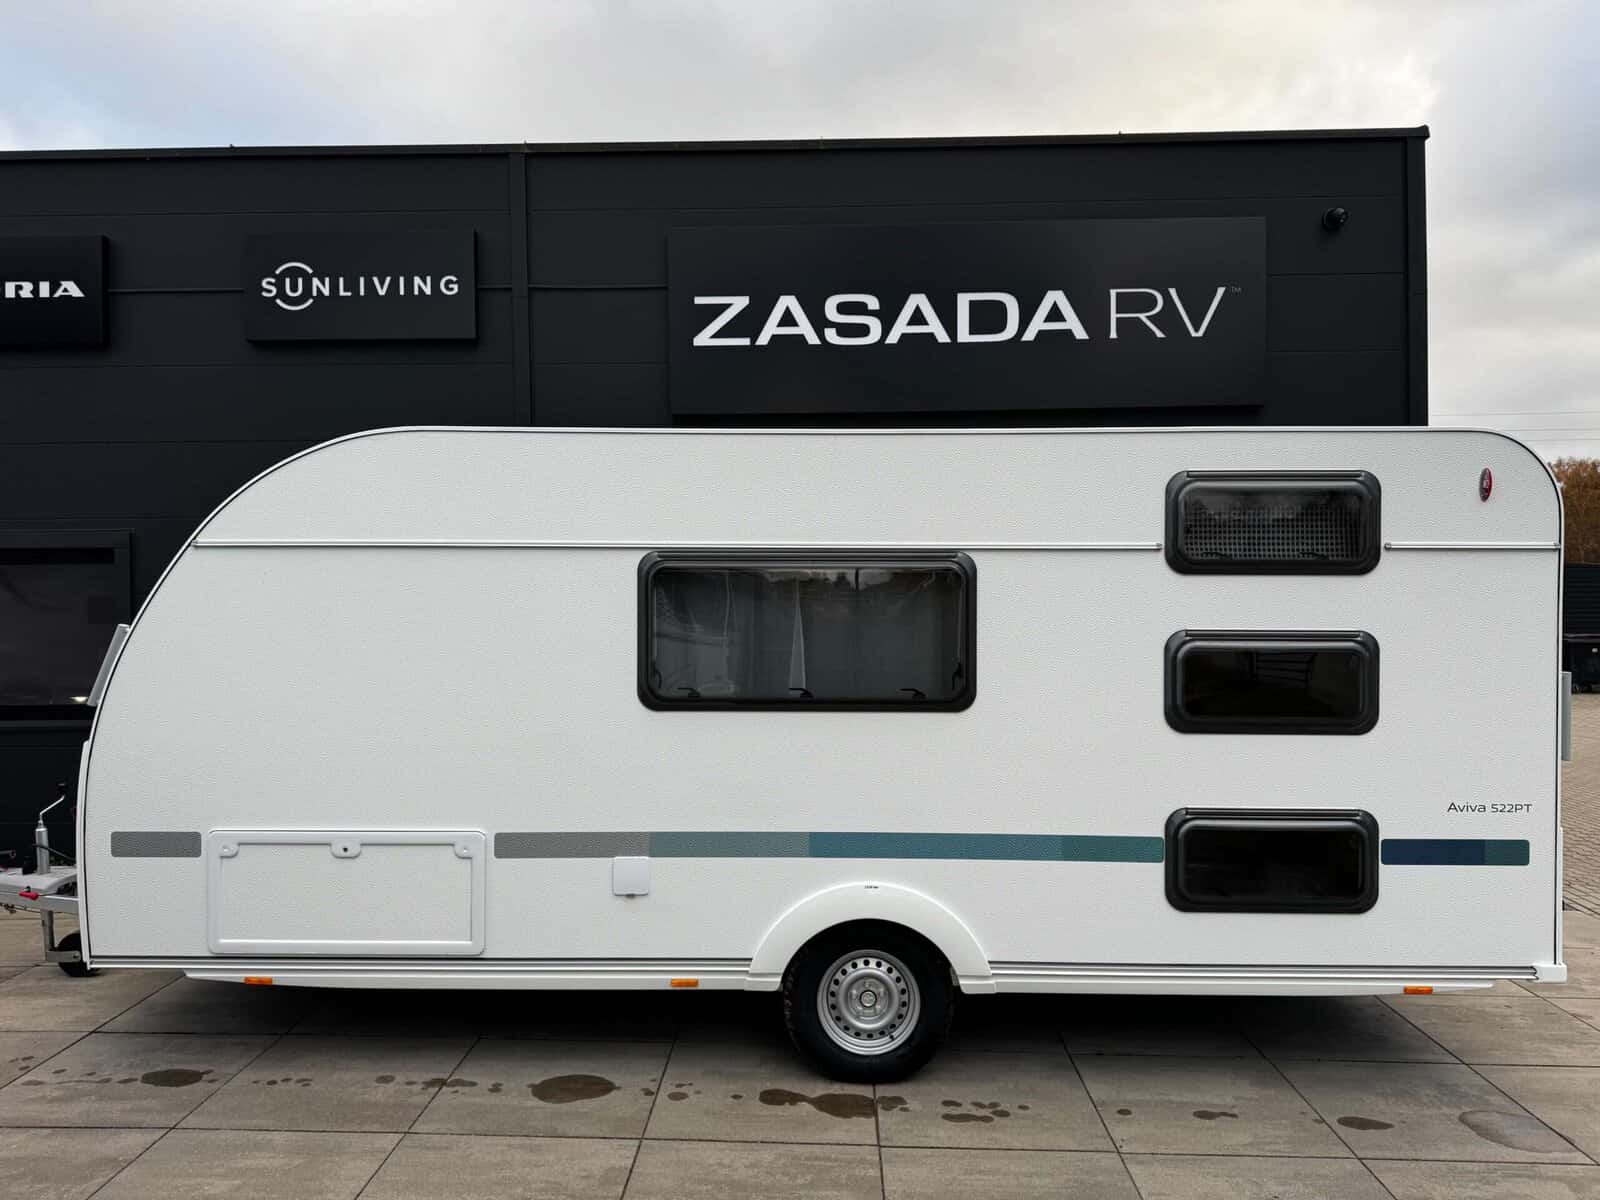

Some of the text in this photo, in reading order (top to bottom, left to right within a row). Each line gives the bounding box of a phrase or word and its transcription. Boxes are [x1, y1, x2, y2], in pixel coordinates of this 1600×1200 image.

[261, 275, 459, 297] SUNLIVING
[692, 289, 1090, 347] ZASADA
[1446, 801, 1533, 813] Aviva 522PT
